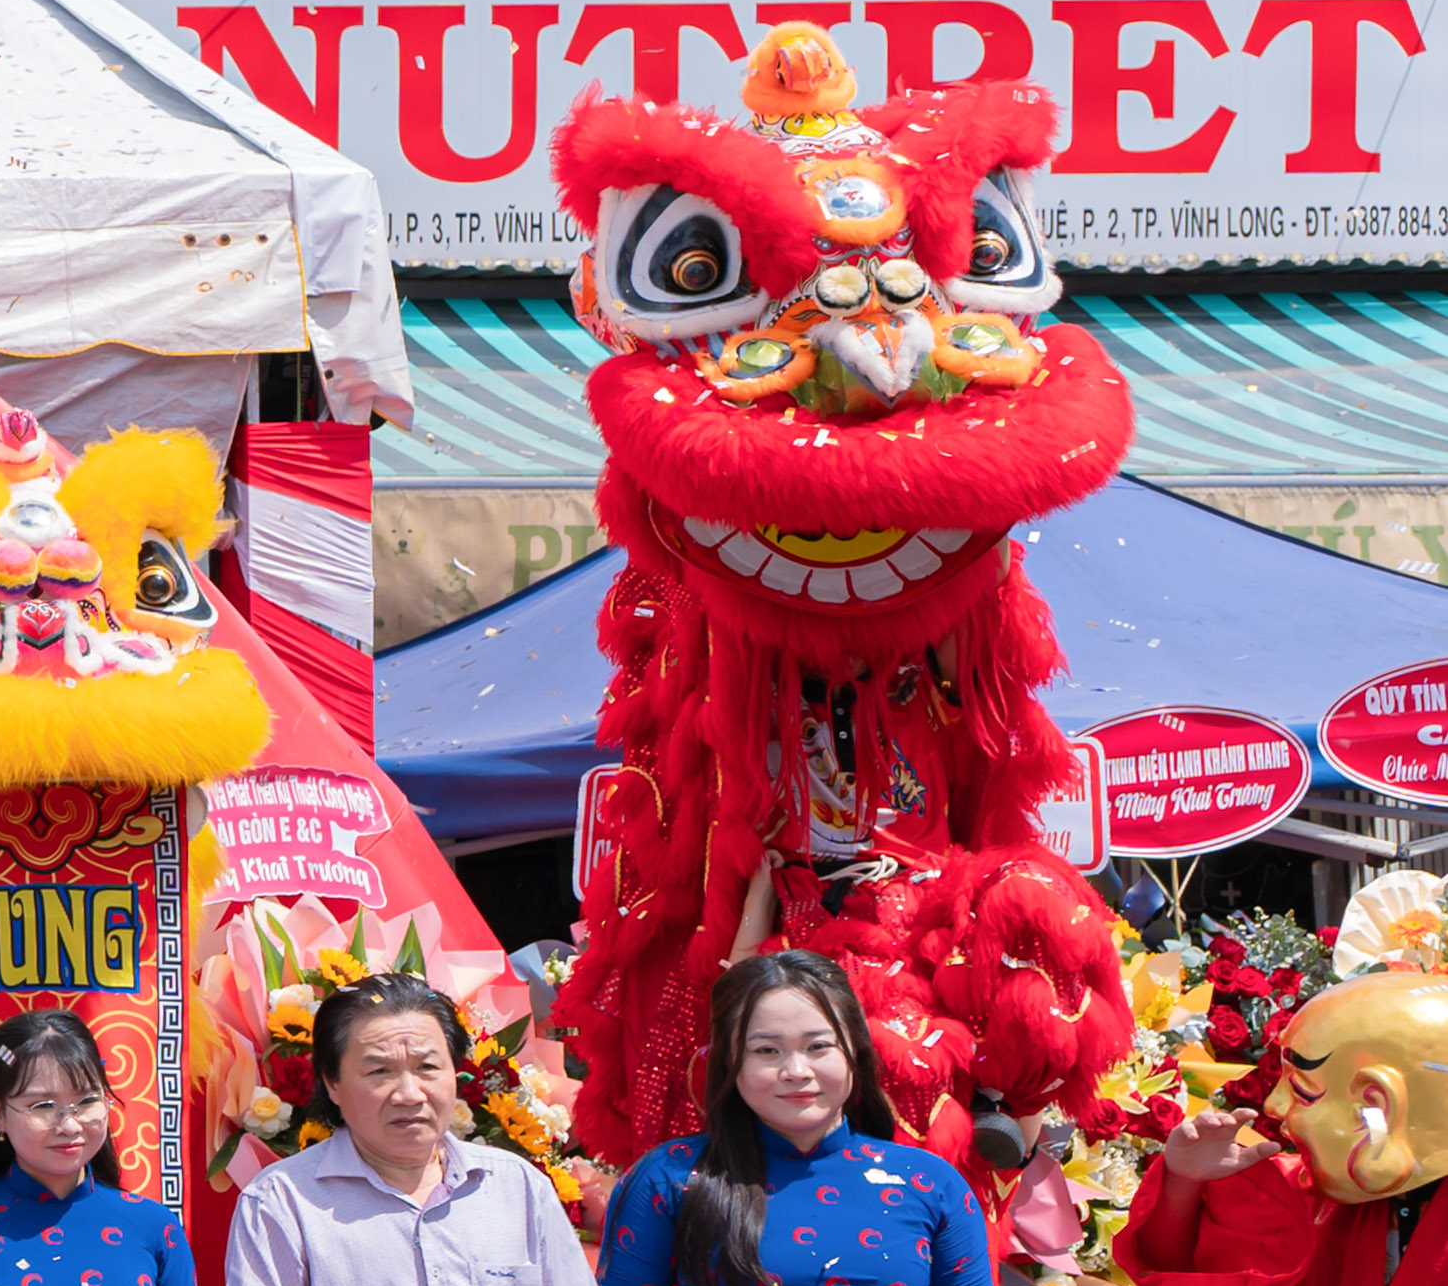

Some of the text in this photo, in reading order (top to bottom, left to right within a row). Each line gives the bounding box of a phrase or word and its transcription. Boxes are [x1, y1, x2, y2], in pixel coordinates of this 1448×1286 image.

[406, 212, 423, 243] P.
[432, 212, 450, 250] 3,
[455, 212, 485, 243] TP.
[494, 204, 543, 243] VĨNH
[1082, 207, 1099, 239] P.
[1107, 207, 1126, 245] 2,
[1133, 206, 1162, 238] TP.
[1171, 200, 1219, 238] VĨNH
[1227, 205, 1285, 238] LONG
[1305, 205, 1338, 238] ĐT:
[1411, 677, 1447, 712] TÍN
[1138, 748, 1169, 787] ĐIỆN
[1169, 749, 1203, 785] LẠNH
[1203, 741, 1247, 776] KHÁNH
[1246, 740, 1290, 772] KHANG
[1382, 754, 1428, 783] Chúc
[318, 777, 350, 818] Công
[343, 782, 377, 826] Nghệ
[1115, 782, 1276, 822] Mừng Khai Trương
[217, 812, 323, 848] ÀI GÒN E &C
[240, 855, 291, 884] Khai
[292, 855, 371, 896] Trương
